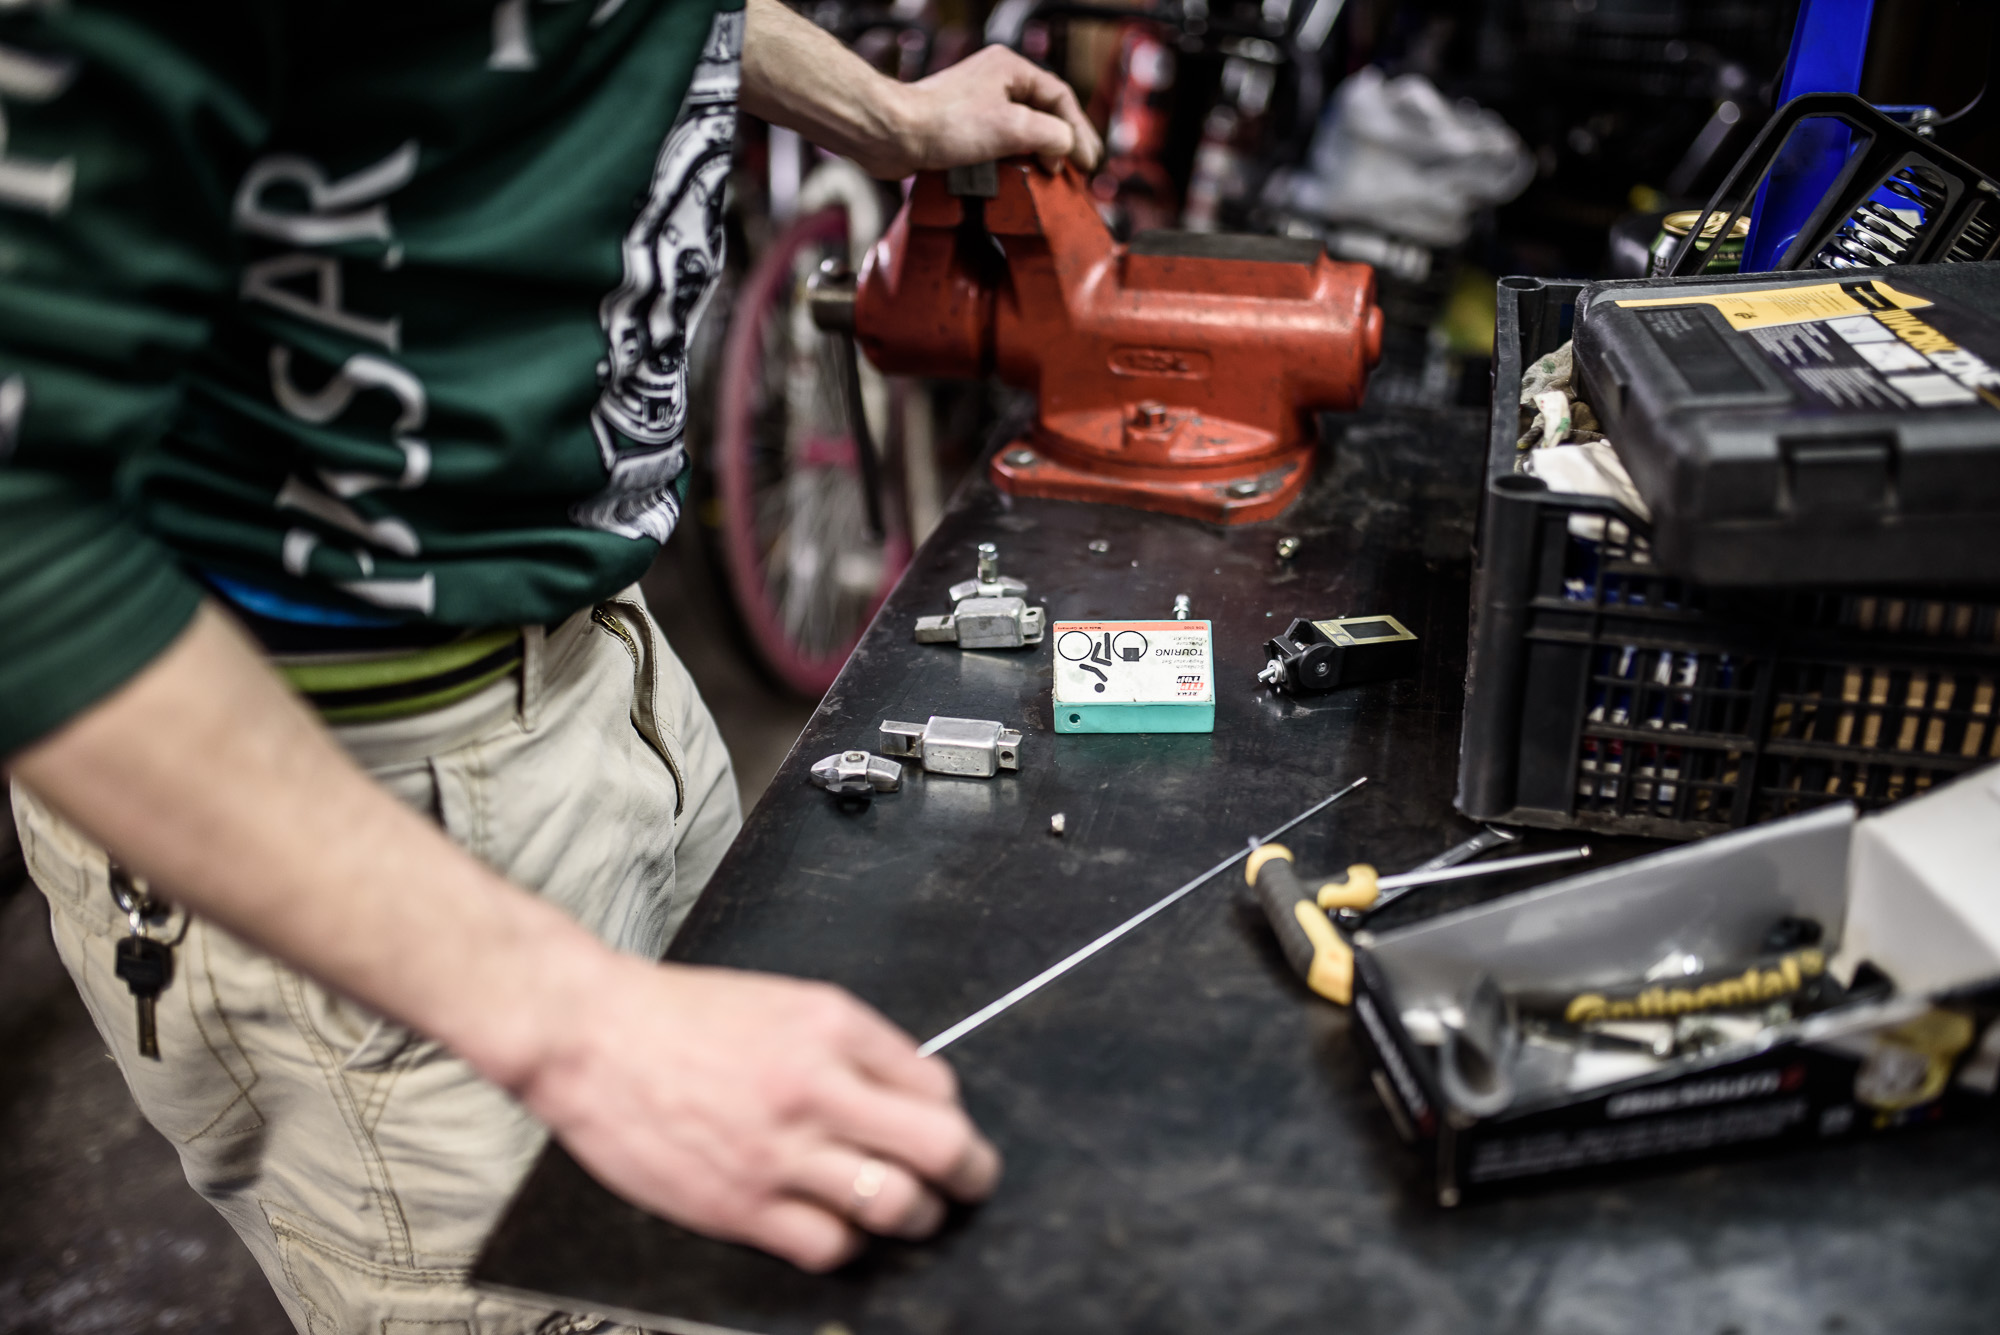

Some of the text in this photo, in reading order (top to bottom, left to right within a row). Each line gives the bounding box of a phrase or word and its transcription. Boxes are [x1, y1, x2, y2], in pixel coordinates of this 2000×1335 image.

[1155, 648, 1204, 657] TOURING
[1180, 682, 1203, 690] TIP
[1564, 954, 1800, 1023] Continental
